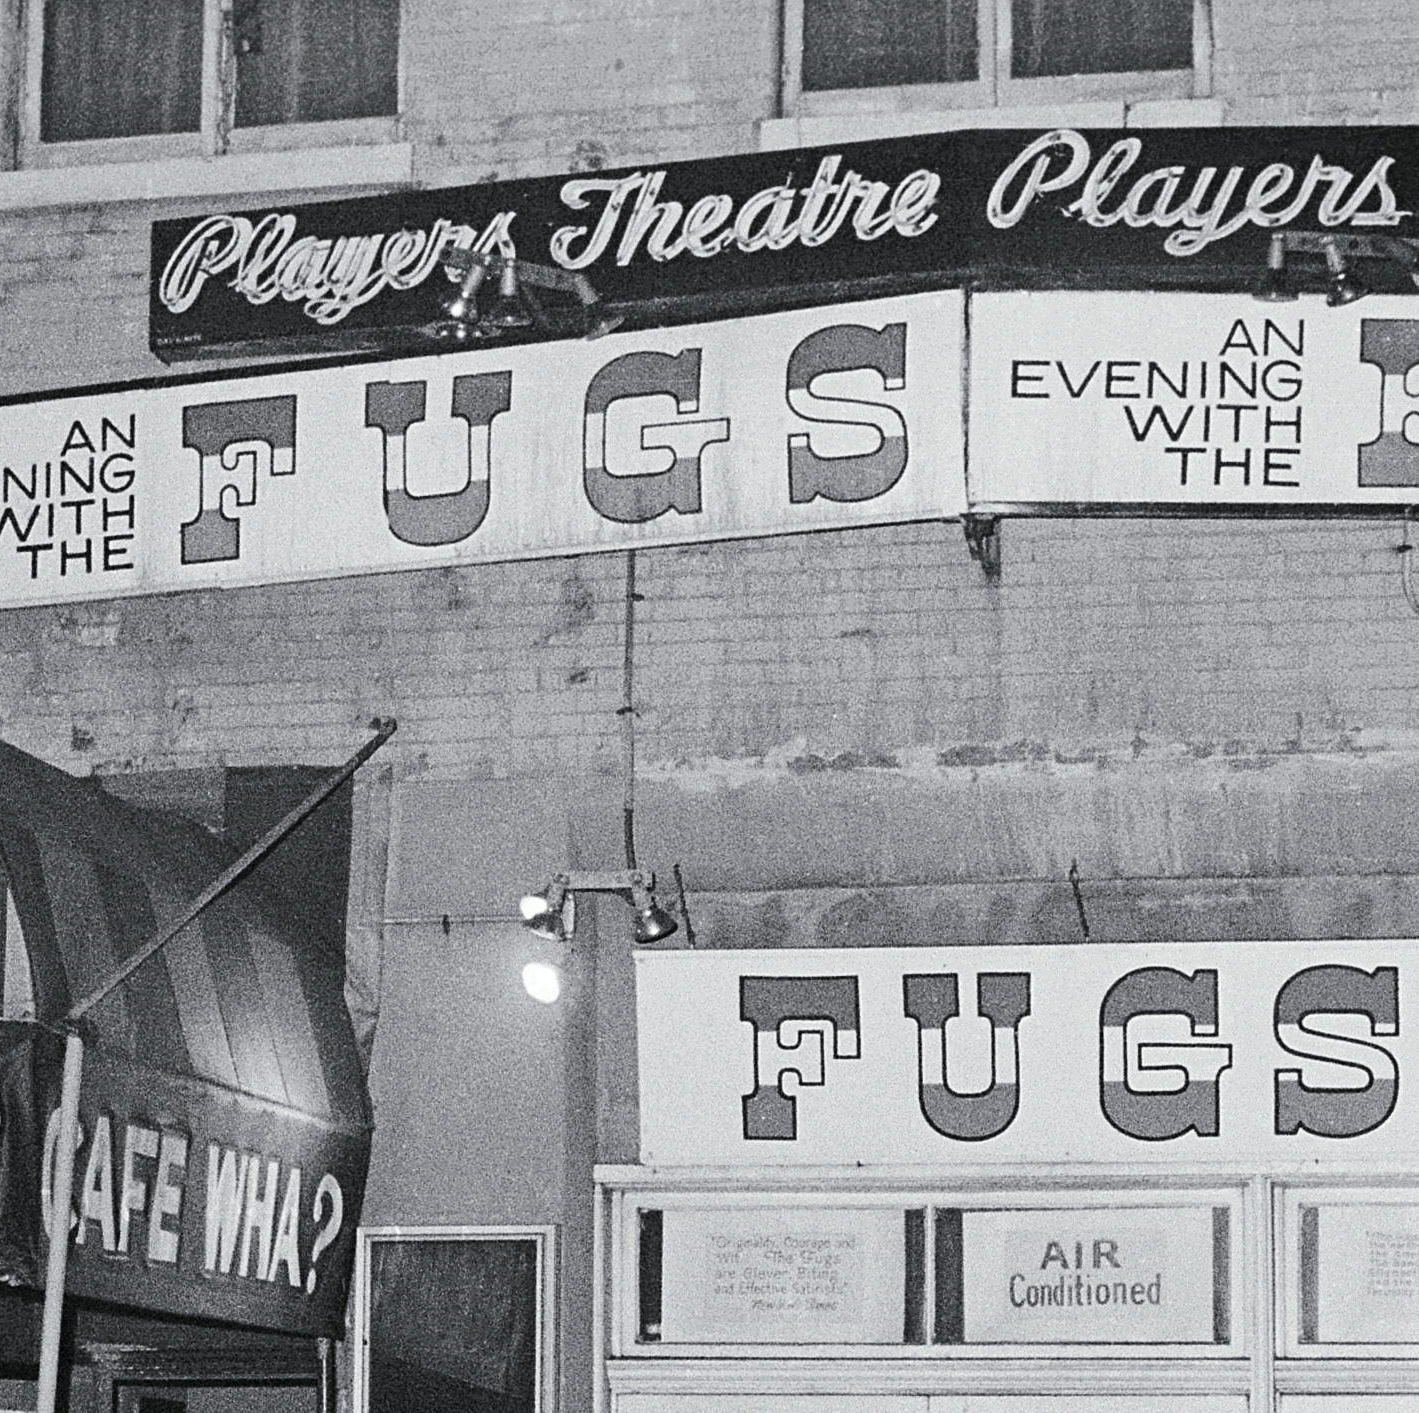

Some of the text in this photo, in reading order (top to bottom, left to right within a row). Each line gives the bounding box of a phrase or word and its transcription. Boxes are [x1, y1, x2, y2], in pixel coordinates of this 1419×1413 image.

[984, 131, 1402, 257] Players
[159, 154, 942, 325] Players Theatre
[1218, 319, 1306, 357] AN
[1008, 359, 1304, 400] EVENING
[61, 413, 136, 457] AN
[180, 320, 910, 566] FUGS
[1123, 403, 1303, 446] WITH
[1165, 446, 1302, 490] THE
[16, 534, 135, 579] THE
[738, 964, 1400, 1142] FUGS
[204, 1143, 344, 1295] WHA?
[1039, 1239, 1122, 1271] AIR
[1008, 1272, 1162, 1309] Conditioned
